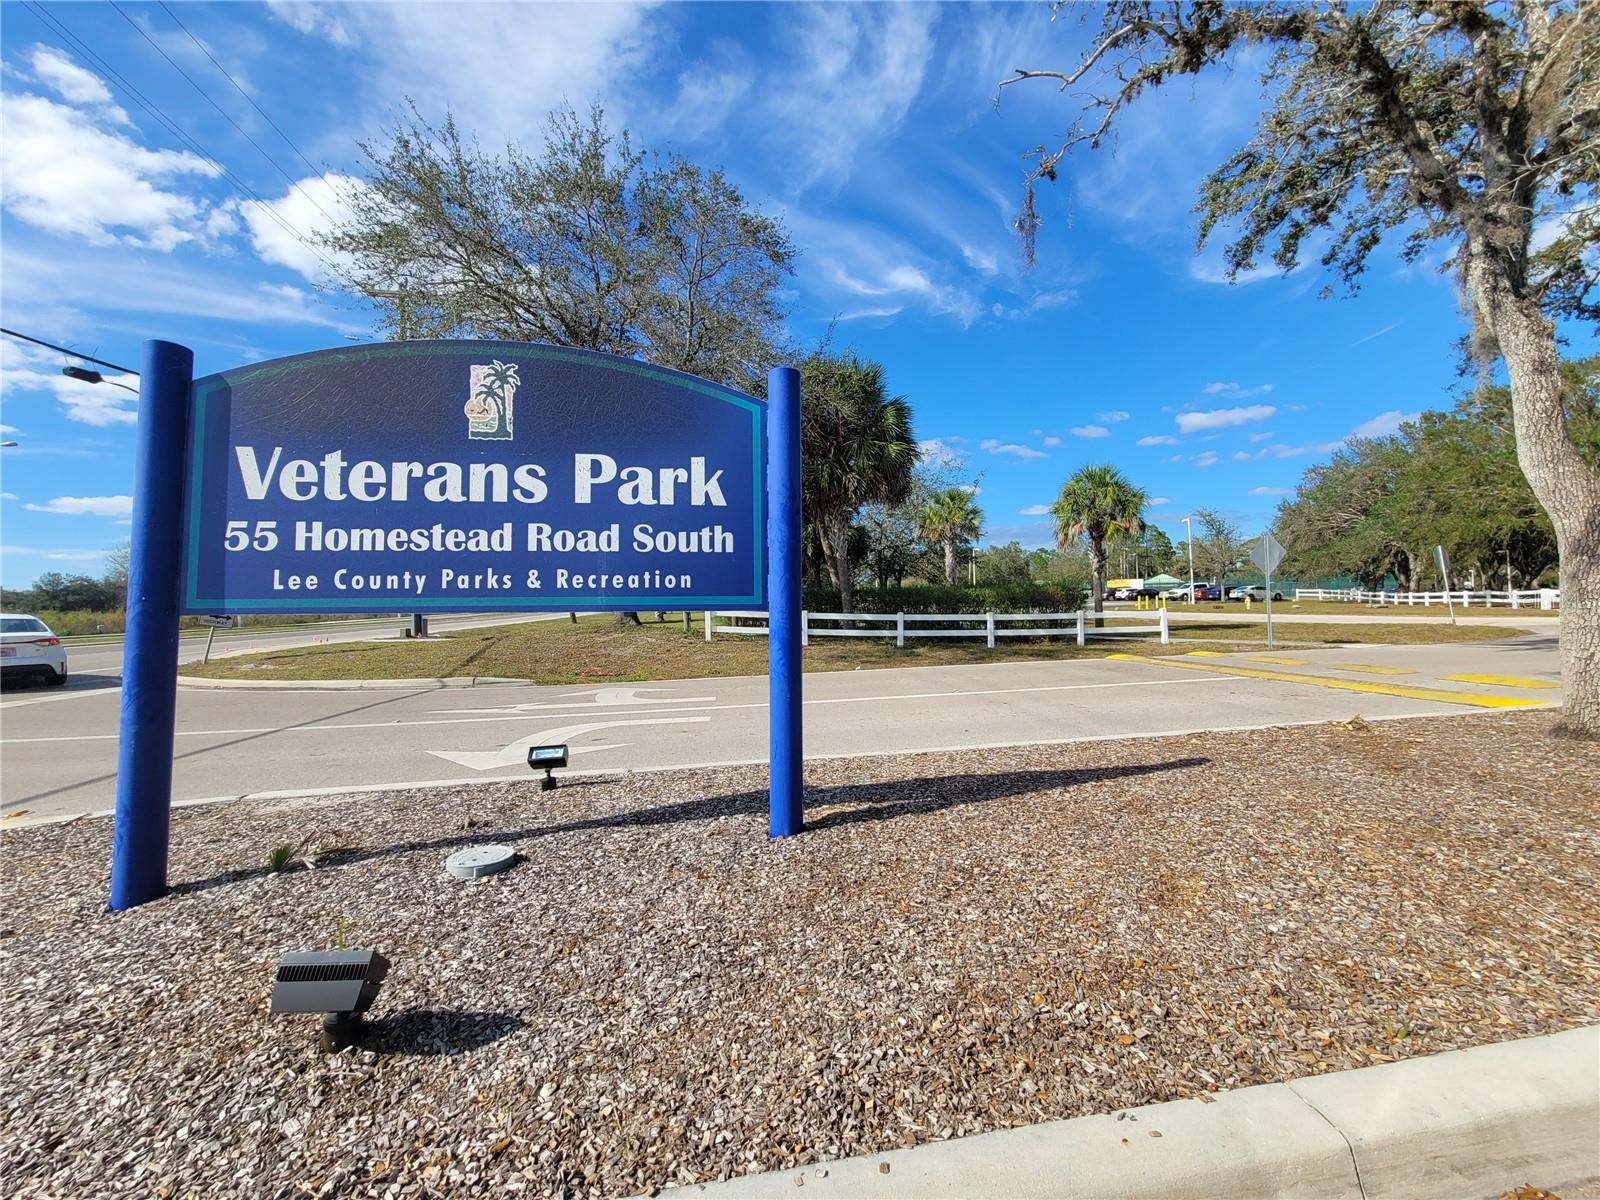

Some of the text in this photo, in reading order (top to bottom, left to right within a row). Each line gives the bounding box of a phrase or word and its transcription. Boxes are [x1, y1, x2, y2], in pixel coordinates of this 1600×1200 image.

[234, 446, 727, 507] Veterans Park
[224, 520, 734, 553] 55 Homestead Road South
[273, 568, 691, 595] Lee County Parks & Recreation
